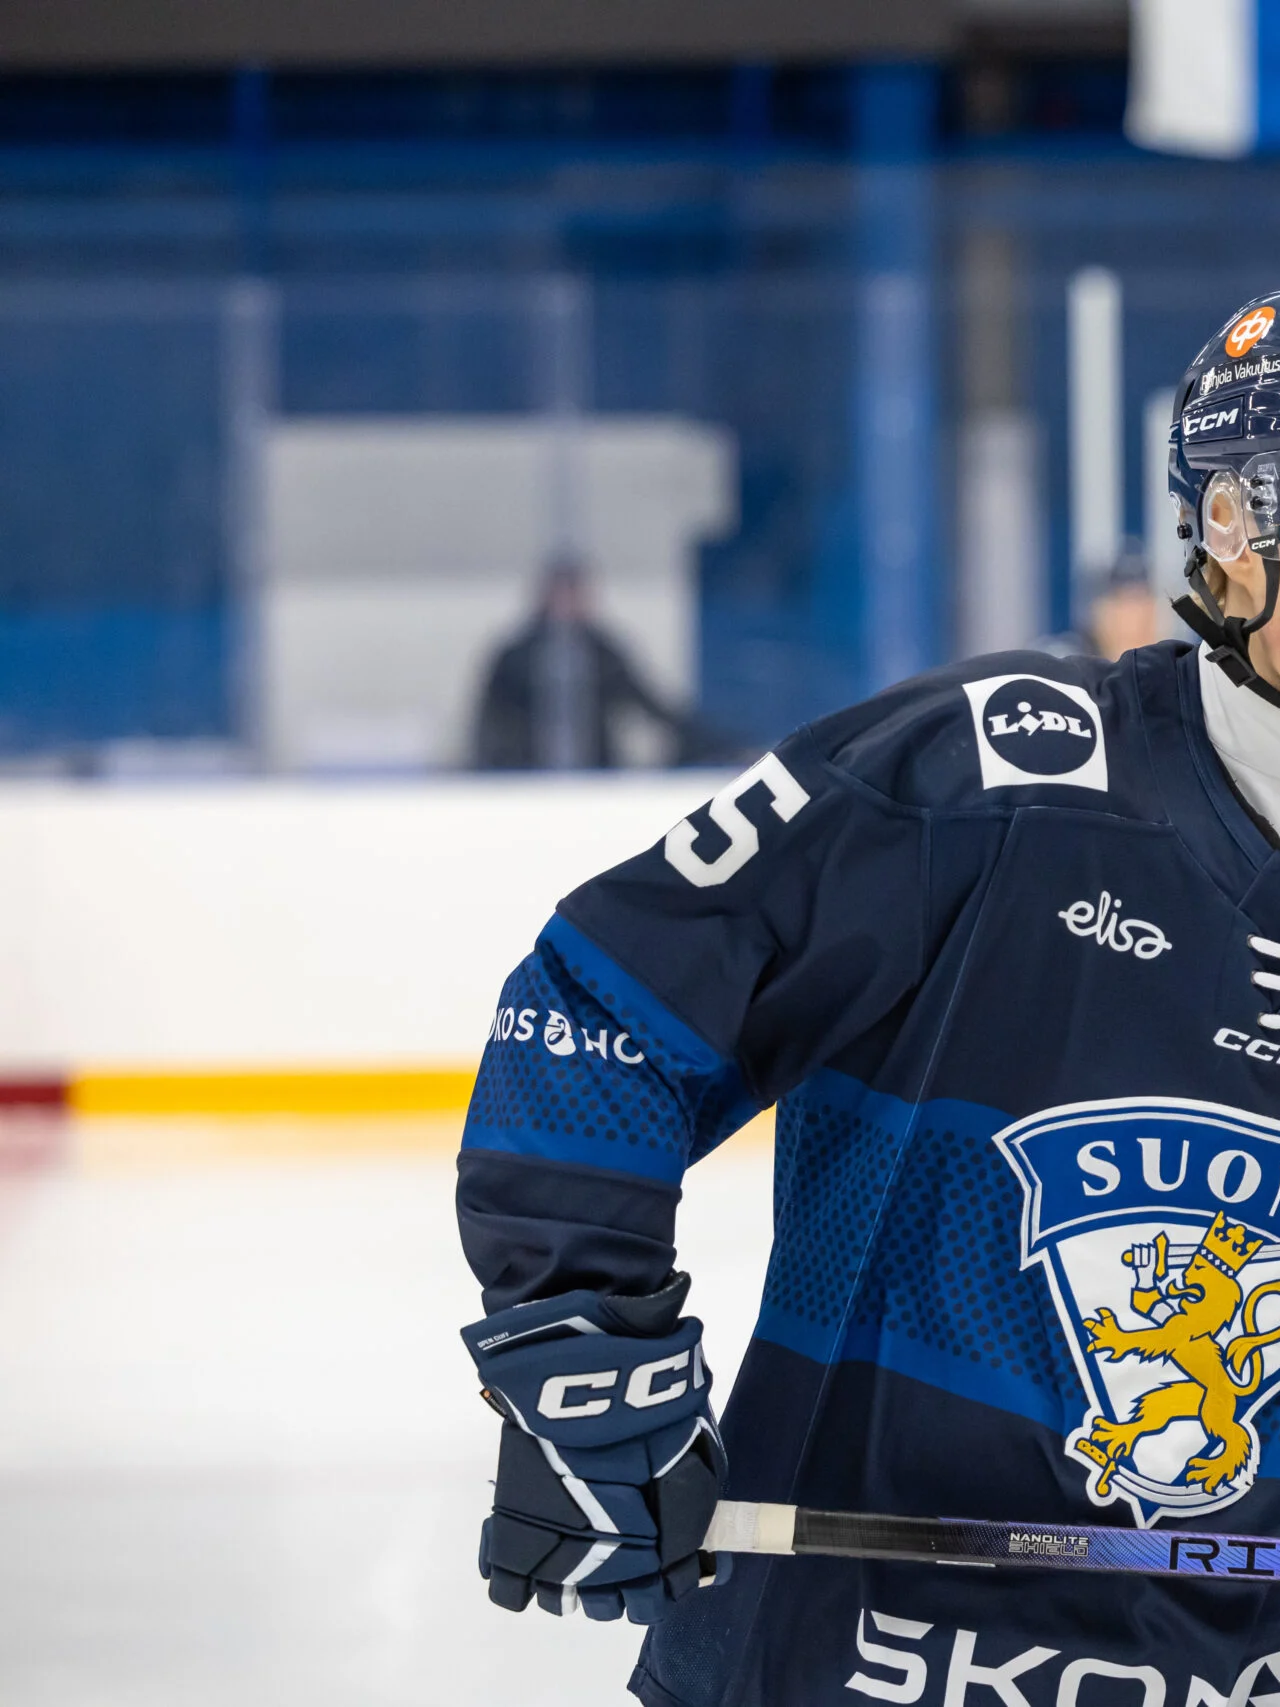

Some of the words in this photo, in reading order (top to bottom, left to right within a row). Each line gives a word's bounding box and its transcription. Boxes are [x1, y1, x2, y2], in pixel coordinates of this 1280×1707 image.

[1183, 408, 1239, 436] CCM
[1251, 538, 1276, 551] CCM
[664, 752, 811, 888] 5
[1058, 890, 1172, 960] elisa
[1008, 1541, 1089, 1557] SHIELD
[1010, 1532, 1089, 1546] NANOLITE
